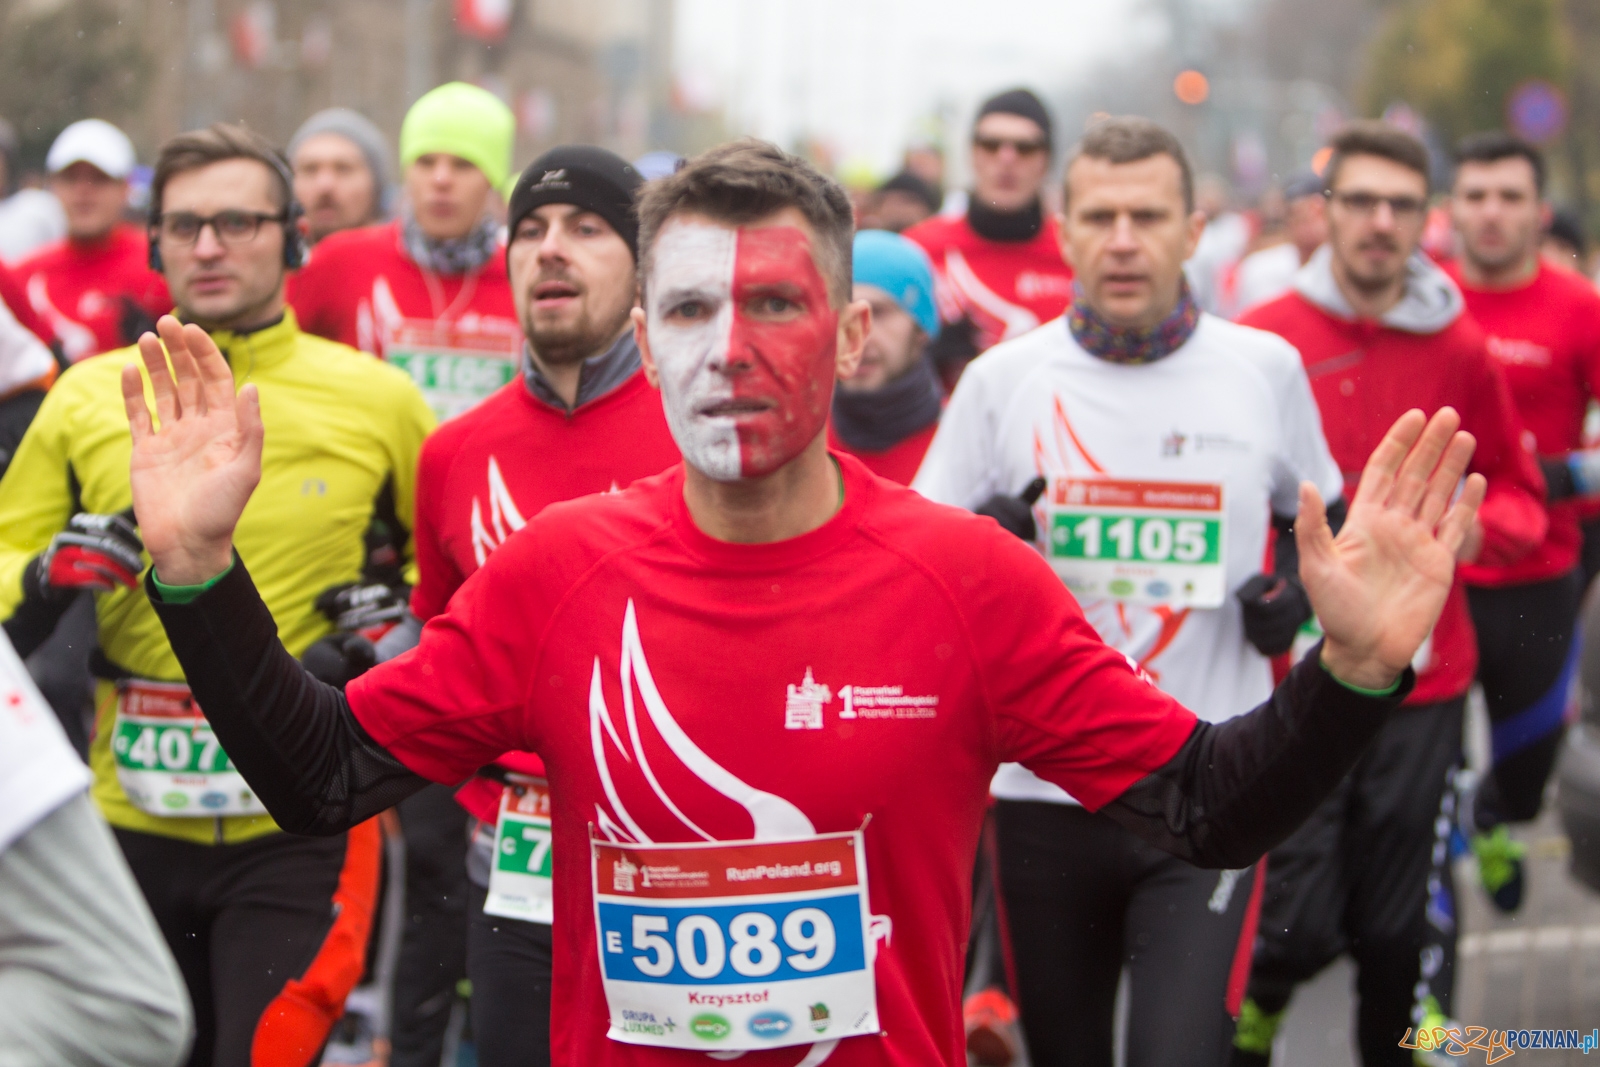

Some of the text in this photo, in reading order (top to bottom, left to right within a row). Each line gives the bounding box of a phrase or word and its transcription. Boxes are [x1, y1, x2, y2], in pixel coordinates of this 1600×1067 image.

[1074, 516, 1208, 562] 1105
[837, 684, 857, 719] 1
[129, 726, 236, 772] 407
[726, 860, 842, 882] RunPoland.org
[605, 907, 837, 979] E 5089
[688, 989, 769, 1007] Krzysztof
[622, 1009, 657, 1023] GRUPA
[623, 1021, 666, 1036] LUXMED
